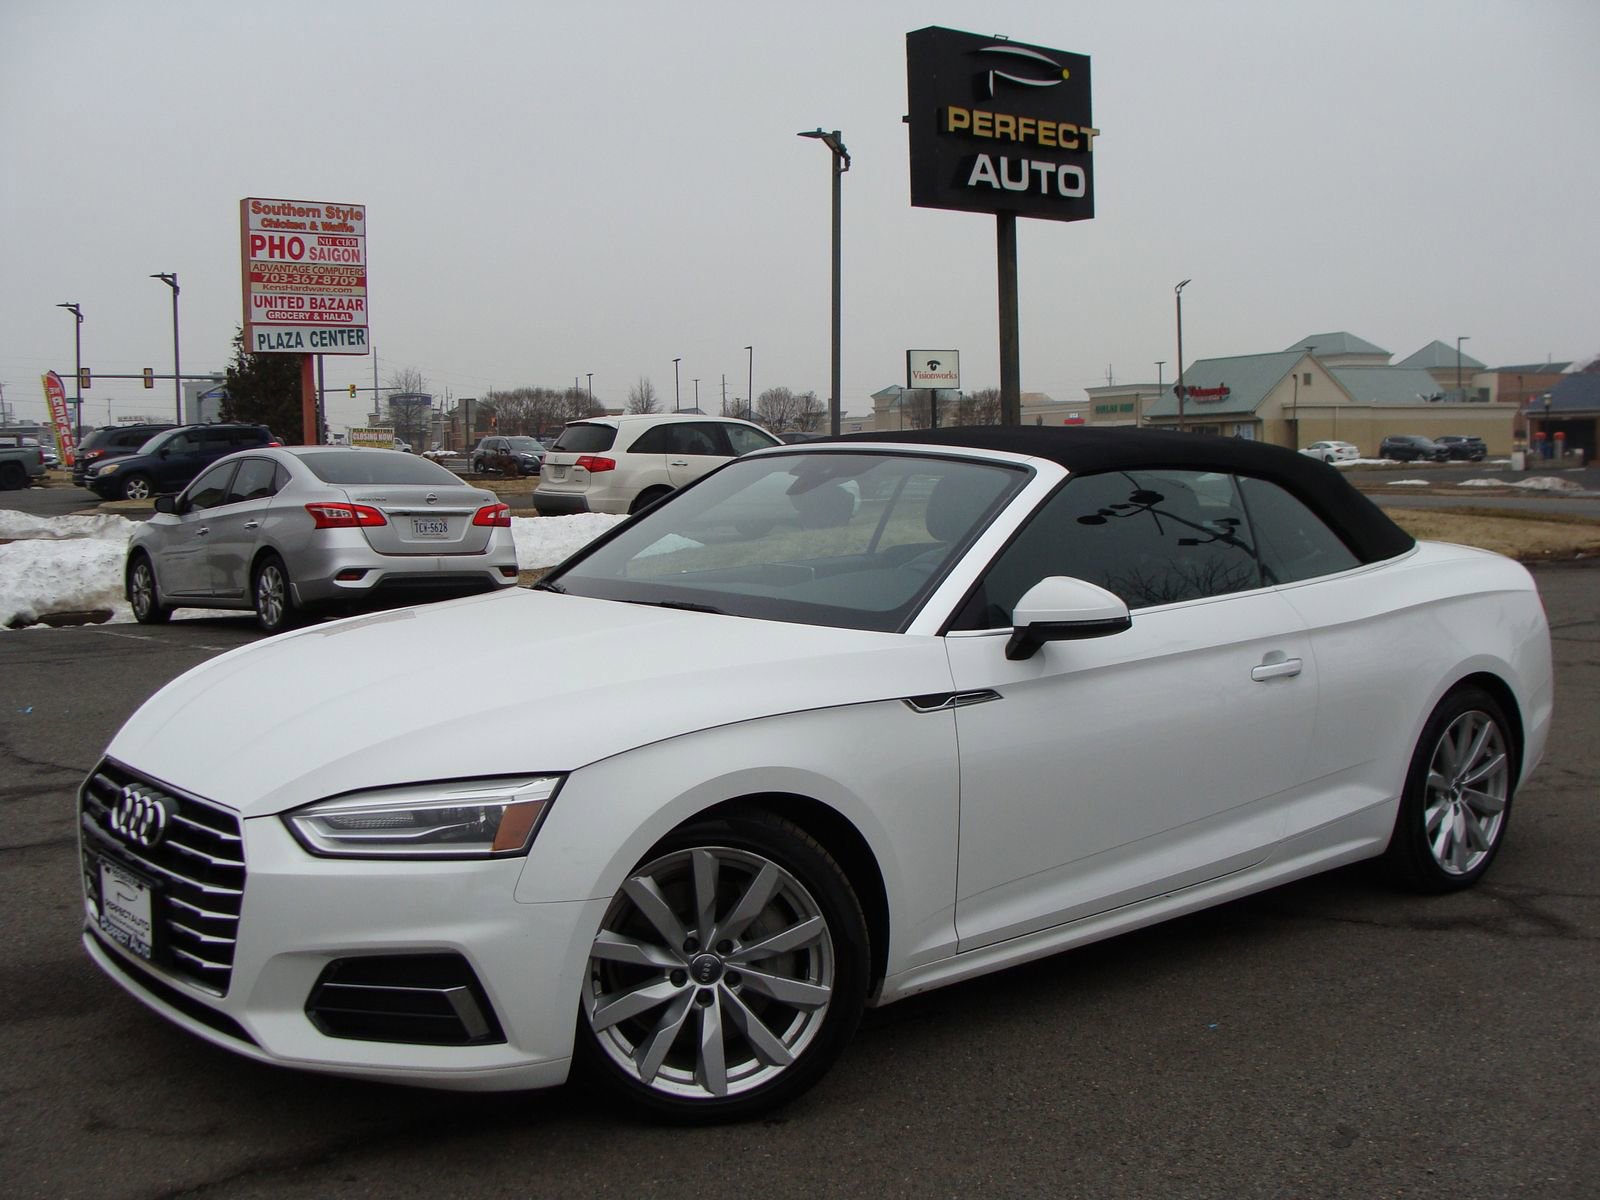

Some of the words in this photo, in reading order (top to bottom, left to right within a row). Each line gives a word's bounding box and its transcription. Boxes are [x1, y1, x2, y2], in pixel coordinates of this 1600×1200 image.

[947, 106, 1100, 152] PERFECT
[968, 153, 1086, 198] AUTO
[251, 200, 322, 218] Southern
[326, 206, 364, 222] Style
[261, 218, 306, 230] Chicken
[310, 221, 318, 230] &
[321, 222, 355, 232] Waffle
[250, 234, 306, 260] PHO
[309, 246, 360, 262] SAIGON
[252, 264, 312, 274] ADVANTAGE
[312, 266, 365, 276] COMPUTERS
[262, 274, 358, 285] 703-367-8709
[262, 284, 352, 294] KensHardware.com
[254, 295, 304, 308] UNITED
[310, 297, 364, 311] BAZAAR
[268, 311, 310, 320] GROCERY
[322, 313, 352, 321] HALAL
[258, 332, 304, 350] PLAZA
[310, 329, 366, 348] CENTER
[912, 370, 958, 380] Visionworks
